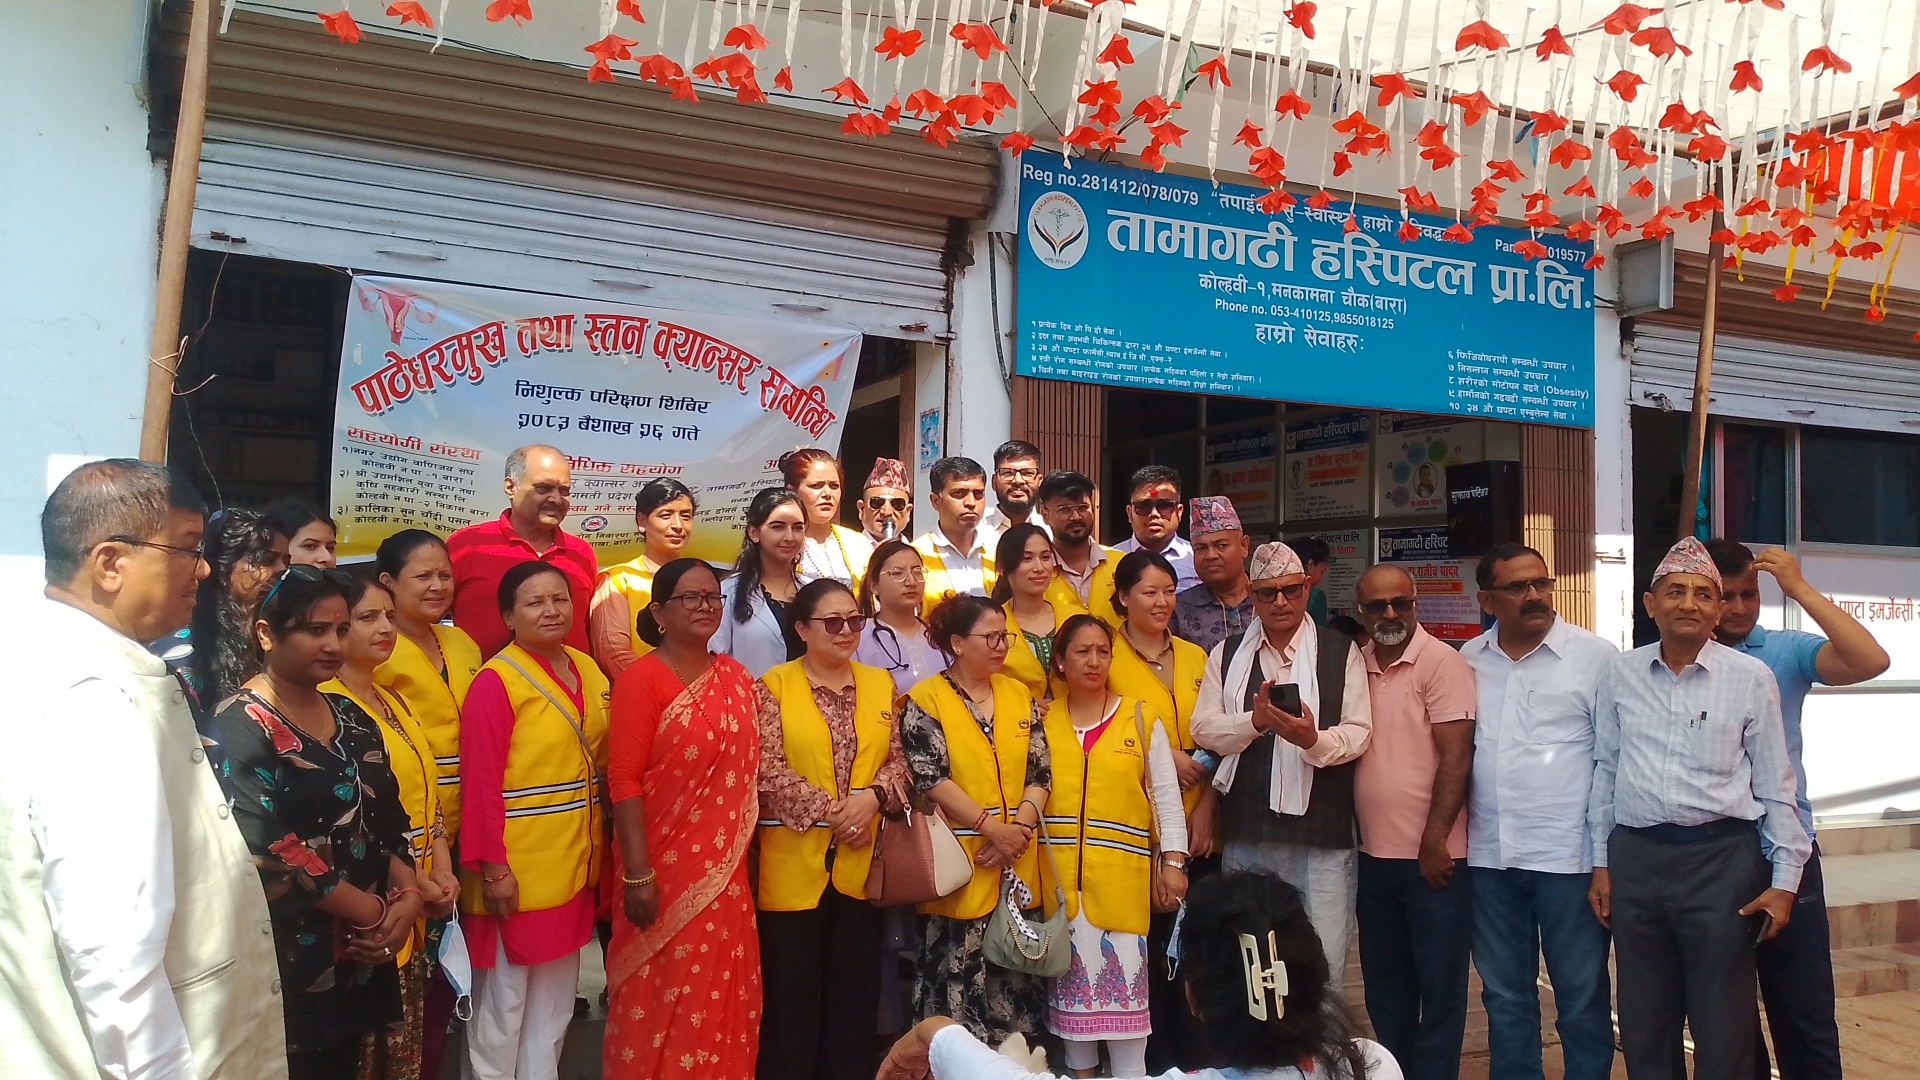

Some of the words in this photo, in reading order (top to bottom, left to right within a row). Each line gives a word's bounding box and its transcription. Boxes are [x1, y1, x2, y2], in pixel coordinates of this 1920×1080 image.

[1023, 163, 1053, 186] Reg
[1057, 173, 1199, 207] no.281412/078/079
[1362, 214, 1393, 233] हाम्रो
[1107, 209, 1299, 272] तामागढी
[1311, 231, 1476, 296] हस्पिटल
[1489, 259, 1592, 310] प्रा.लि.
[1215, 298, 1249, 313] Phone
[1251, 305, 1268, 315] no.
[1270, 304, 1395, 330] 053-410125,9855018125
[515, 314, 577, 357] तथा
[583, 313, 651, 358] स्तन
[1255, 321, 1296, 345] हाम्रो
[1542, 361, 1568, 372] उपचार
[1523, 371, 1550, 382] उपचार
[515, 379, 585, 405] निशुल्क
[589, 388, 654, 409] परिक्षण
[658, 394, 712, 414] शिबिर
[1551, 398, 1578, 410] उपचार
[578, 414, 634, 435] बैशाख
[672, 424, 701, 441] गते
[347, 426, 423, 451] सहयोगी
[429, 441, 483, 460] संस्था
[355, 470, 367, 478] श्री
[621, 463, 684, 476] सहयोग
[383, 483, 420, 496] सहकारी
[607, 493, 634, 502] प्रदेश
[354, 502, 394, 514] कालिका
